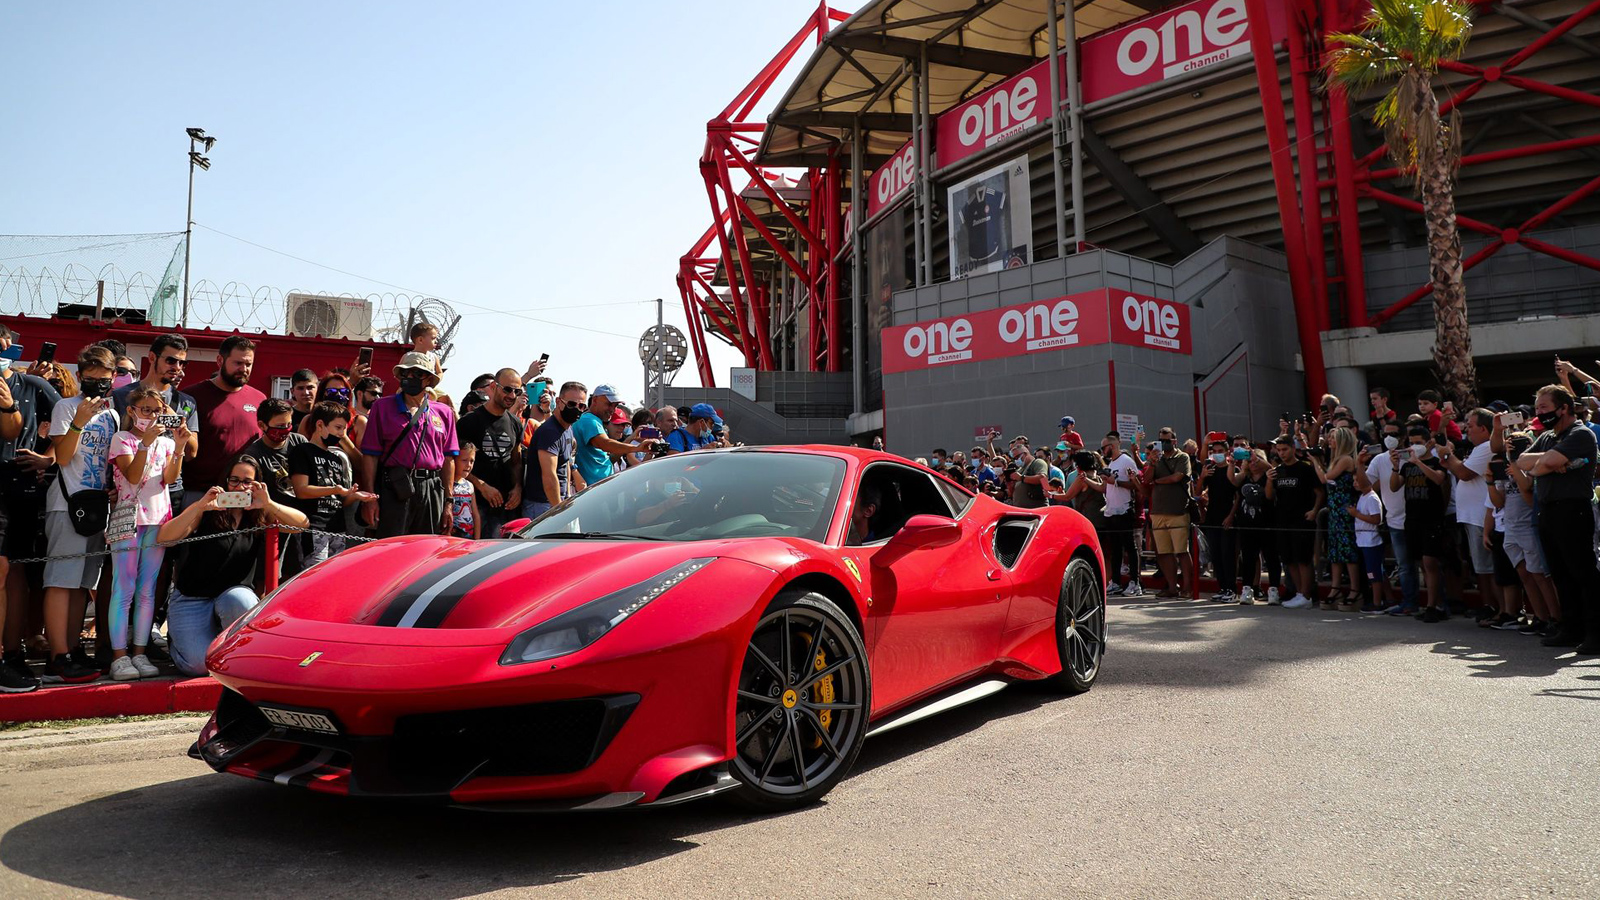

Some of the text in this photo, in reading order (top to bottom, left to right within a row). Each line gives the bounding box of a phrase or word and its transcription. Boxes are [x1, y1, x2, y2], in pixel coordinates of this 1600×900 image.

[1117, 0, 1249, 76] one
[1183, 49, 1230, 72] channel
[958, 76, 1038, 147] one
[996, 123, 1026, 144] channel
[878, 146, 914, 204] one
[954, 261, 978, 277] READY
[998, 300, 1079, 343] one
[1122, 296, 1180, 338] one
[903, 318, 973, 358] one
[1028, 336, 1068, 348] channel
[1153, 337, 1173, 348] channel
[937, 352, 962, 362] channel
[314, 456, 326, 465] UP
